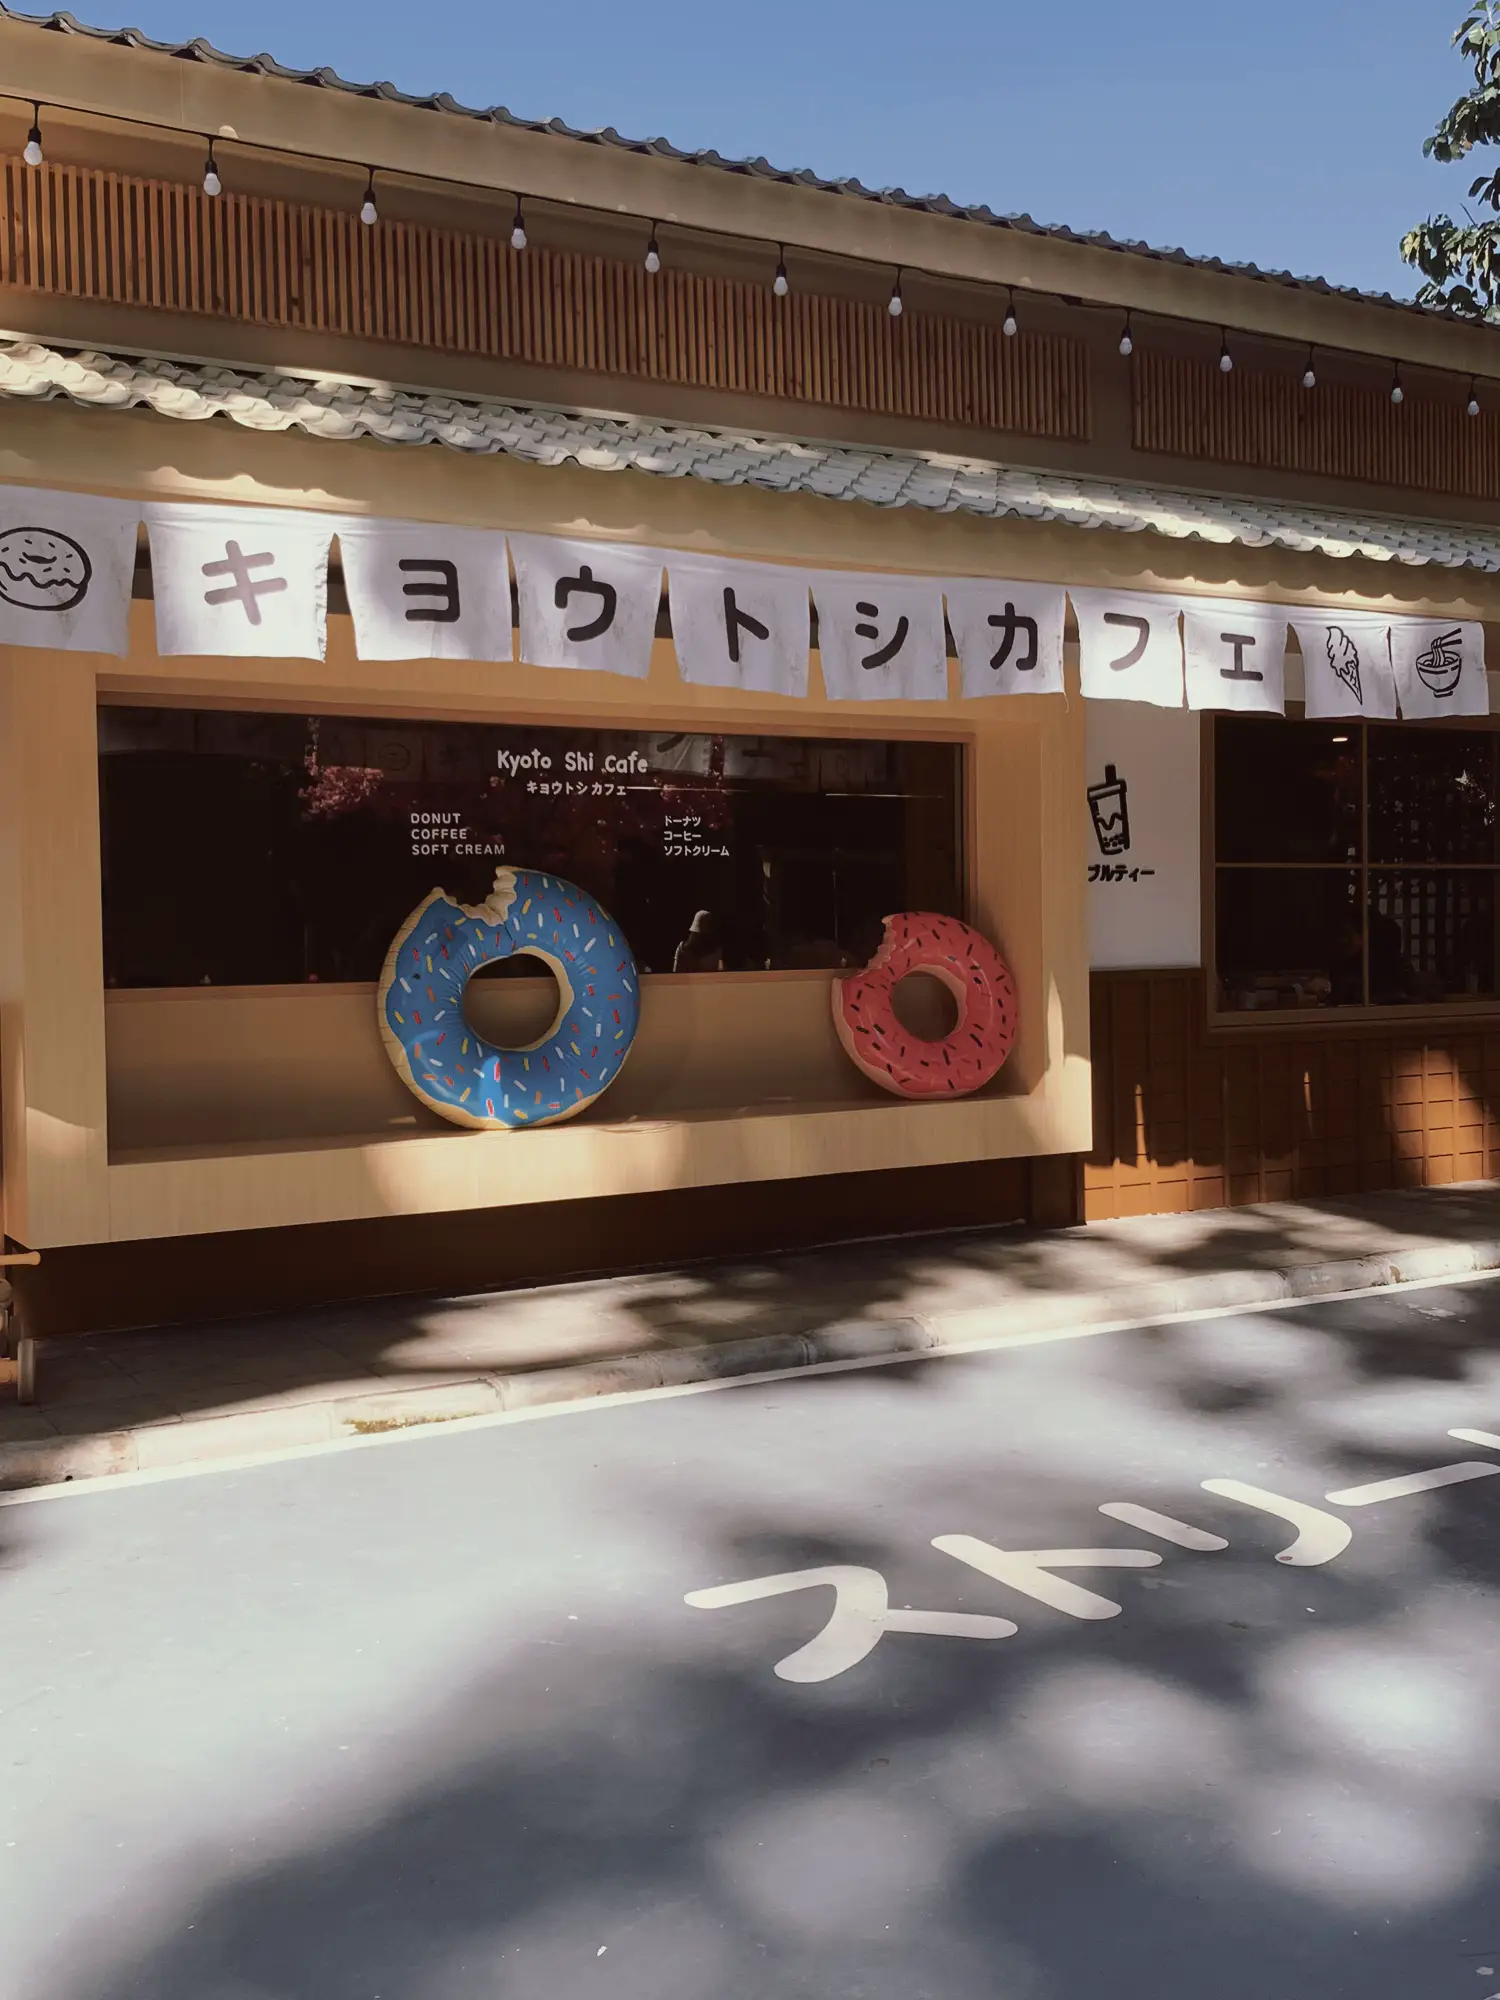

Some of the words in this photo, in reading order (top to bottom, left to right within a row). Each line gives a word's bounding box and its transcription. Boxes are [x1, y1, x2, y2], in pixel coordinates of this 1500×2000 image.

[497, 748, 552, 777] Kyoto
[565, 751, 594, 772] Shi
[605, 750, 649, 774] Cafe
[410, 812, 461, 824] DONUT
[664, 815, 701, 827] ドーナツ
[410, 828, 468, 840] COFFEE
[663, 830, 702, 842] コーヒー
[411, 844, 449, 856] SOFT
[455, 844, 505, 855] CREAM
[663, 845, 730, 857] ソフトクリーム
[683, 1428, 1500, 1684] ストリー
